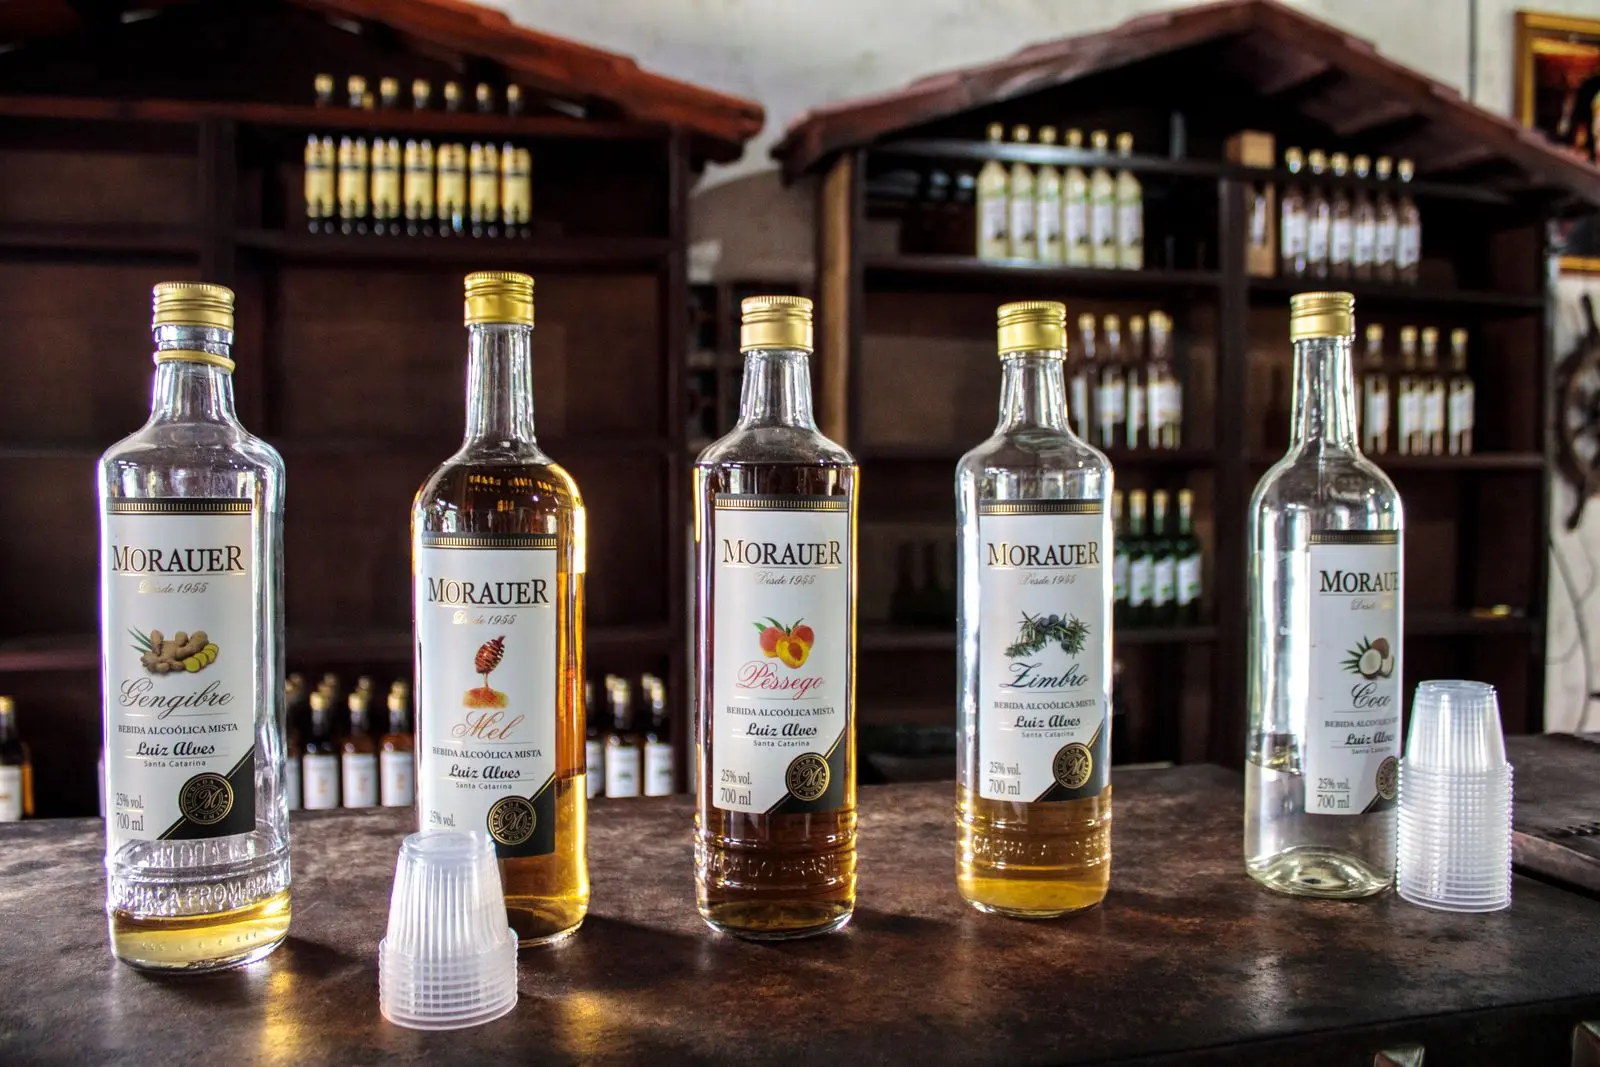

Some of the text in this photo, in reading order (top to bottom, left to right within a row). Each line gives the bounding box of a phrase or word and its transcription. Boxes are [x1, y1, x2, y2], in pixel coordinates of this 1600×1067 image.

[112, 545, 244, 572] MORAUER
[723, 539, 842, 565] MORAUER
[987, 541, 1099, 566] MORAUER
[789, 574, 816, 585] 1955
[177, 582, 209, 594] 1955
[428, 577, 549, 605] MORAUER
[488, 614, 517, 625] 1955
[736, 660, 824, 700] Pêssego
[999, 662, 1089, 688] Zimbro
[119, 677, 234, 720] Gengibre
[994, 701, 1024, 710] BEBIDA
[1025, 700, 1075, 710] ALCOÓLICA
[726, 706, 835, 717] BEBIDA ALCOÓLICA MISTA
[118, 723, 239, 735] BEBIDA ALCOÓLICA MISTA
[451, 711, 525, 740] Mel
[746, 722, 817, 736] Luiz Alves
[1014, 715, 1081, 728] Luiz Alves
[1344, 732, 1371, 745] Luiz
[136, 741, 216, 756] Luiz Alves
[432, 746, 542, 759] BEBIDA ALCOÓLICA MISTA
[144, 760, 206, 768] Santa Catarina
[449, 764, 521, 779] Luiz Alves
[989, 761, 1021, 775] 25% vol.
[721, 769, 752, 785] 25% vol.
[1316, 778, 1335, 790] 25%
[456, 782, 476, 790] Santa
[989, 779, 1020, 795] 700 ml
[116, 792, 144, 809] 25% vol.
[720, 787, 752, 806] 700 ml
[1316, 795, 1350, 809] 700 ml
[116, 812, 144, 831] 700 ml
[443, 813, 456, 828] vol.
[185, 881, 242, 910] FROM
